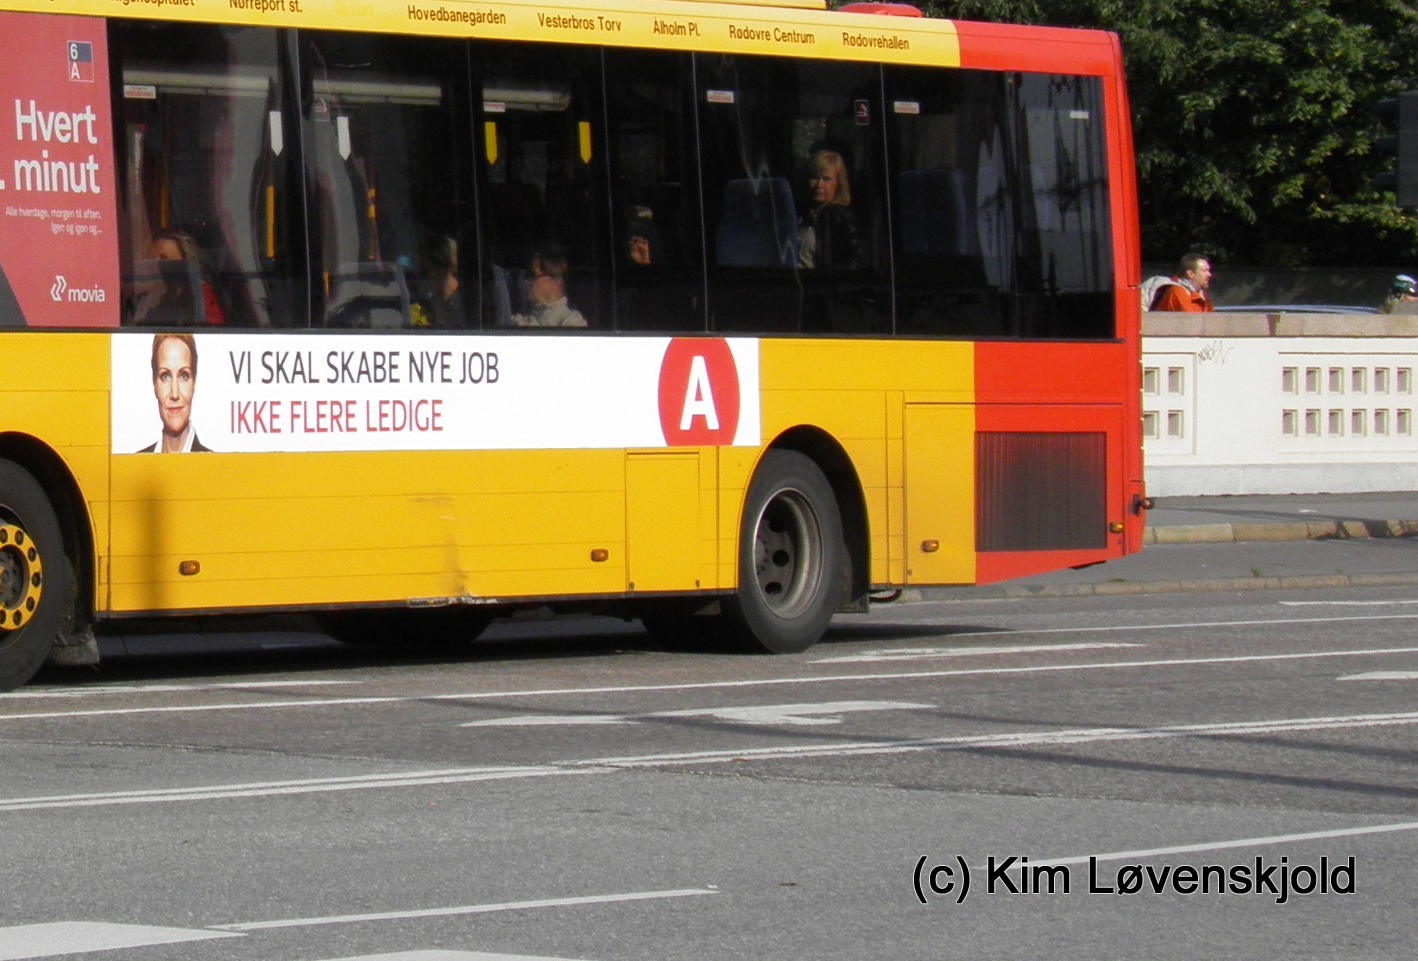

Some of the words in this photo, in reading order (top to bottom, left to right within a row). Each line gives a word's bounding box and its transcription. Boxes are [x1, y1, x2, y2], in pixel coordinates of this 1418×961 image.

[407, 5, 507, 26] Hovedbanegården
[537, 12, 595, 31] Vesterbros
[597, 16, 622, 32] Torv
[653, 16, 687, 36] Ålholm
[688, 22, 701, 37] Pl.
[729, 24, 771, 41] Rødovre
[773, 28, 815, 45] Centrum
[70, 43, 79, 60] 6
[842, 32, 910, 51] Rødovrehallen
[70, 62, 81, 80] A
[15, 99, 98, 144] Hvert
[14, 150, 101, 194] minut
[68, 285, 105, 303] movia
[229, 351, 251, 384] VI
[261, 350, 320, 384] SKAL
[326, 350, 400, 384] SKABE
[408, 351, 453, 384] NYE
[459, 352, 499, 384] JOB
[679, 356, 720, 430] A
[230, 400, 281, 434] IKKE
[290, 400, 358, 433] FLERE
[366, 399, 443, 433] LEDIGE
